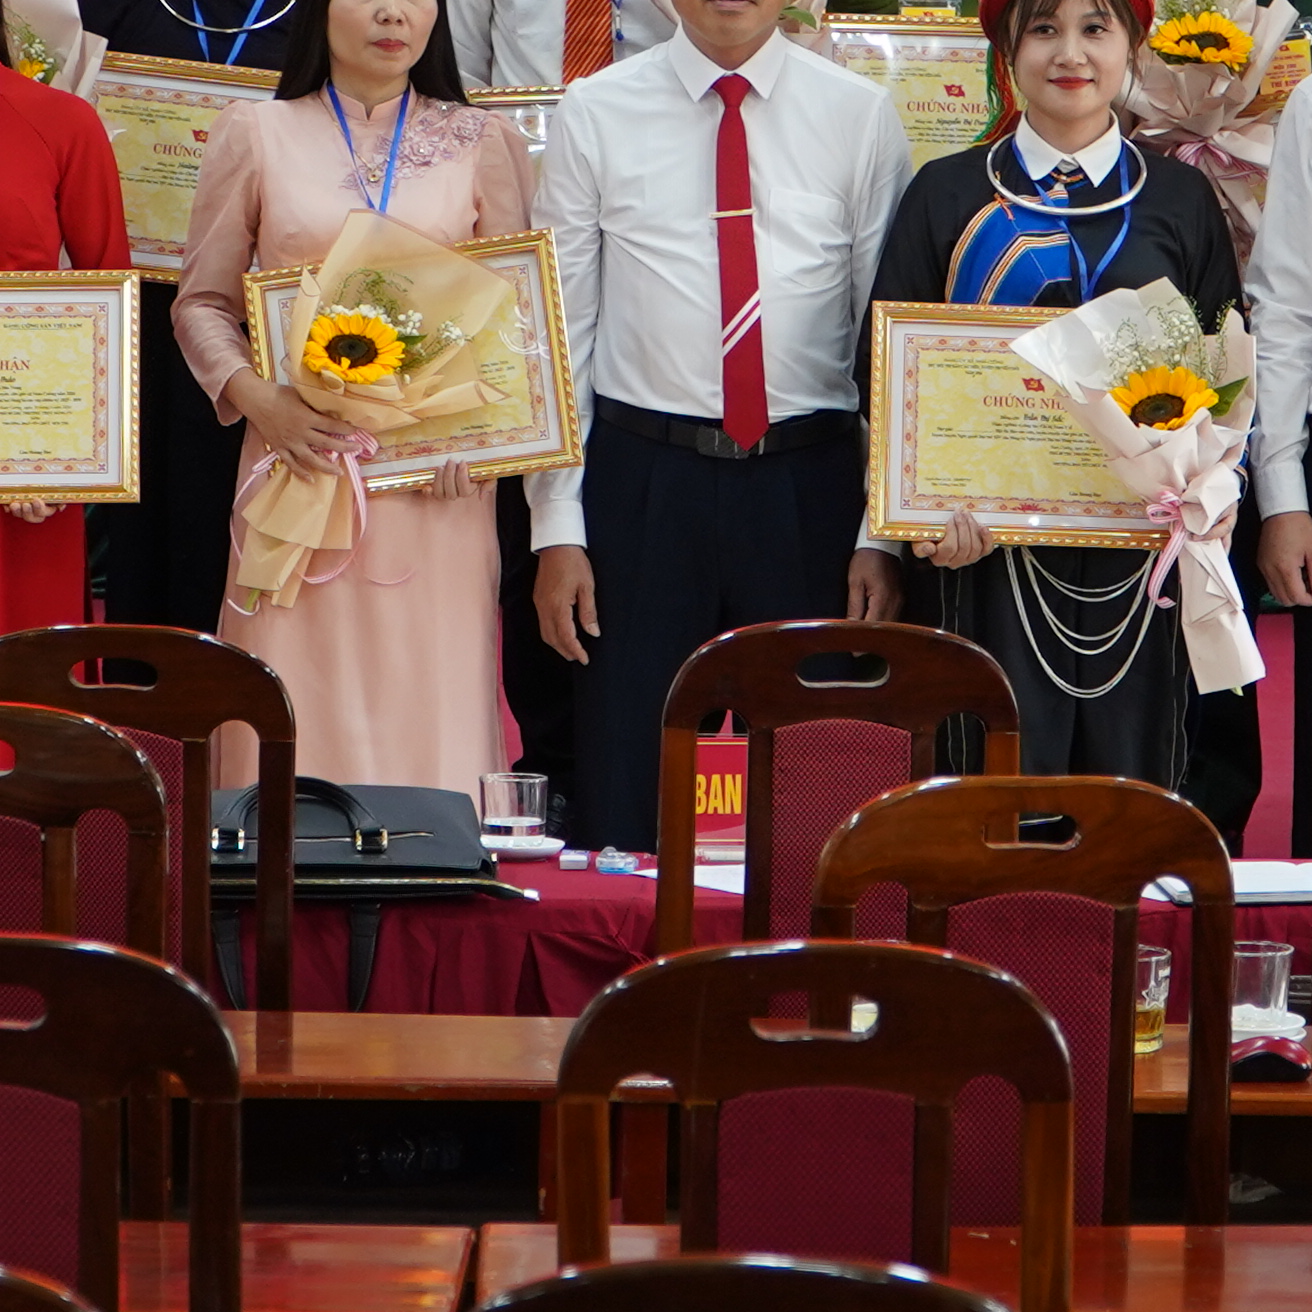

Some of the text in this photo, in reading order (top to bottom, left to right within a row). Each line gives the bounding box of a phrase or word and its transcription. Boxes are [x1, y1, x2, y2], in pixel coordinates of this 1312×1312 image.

[907, 99, 956, 113] CHỨNG
[153, 143, 203, 158] CHỨNG
[983, 393, 1035, 408] CHỨNG
[696, 774, 742, 815] BAN
